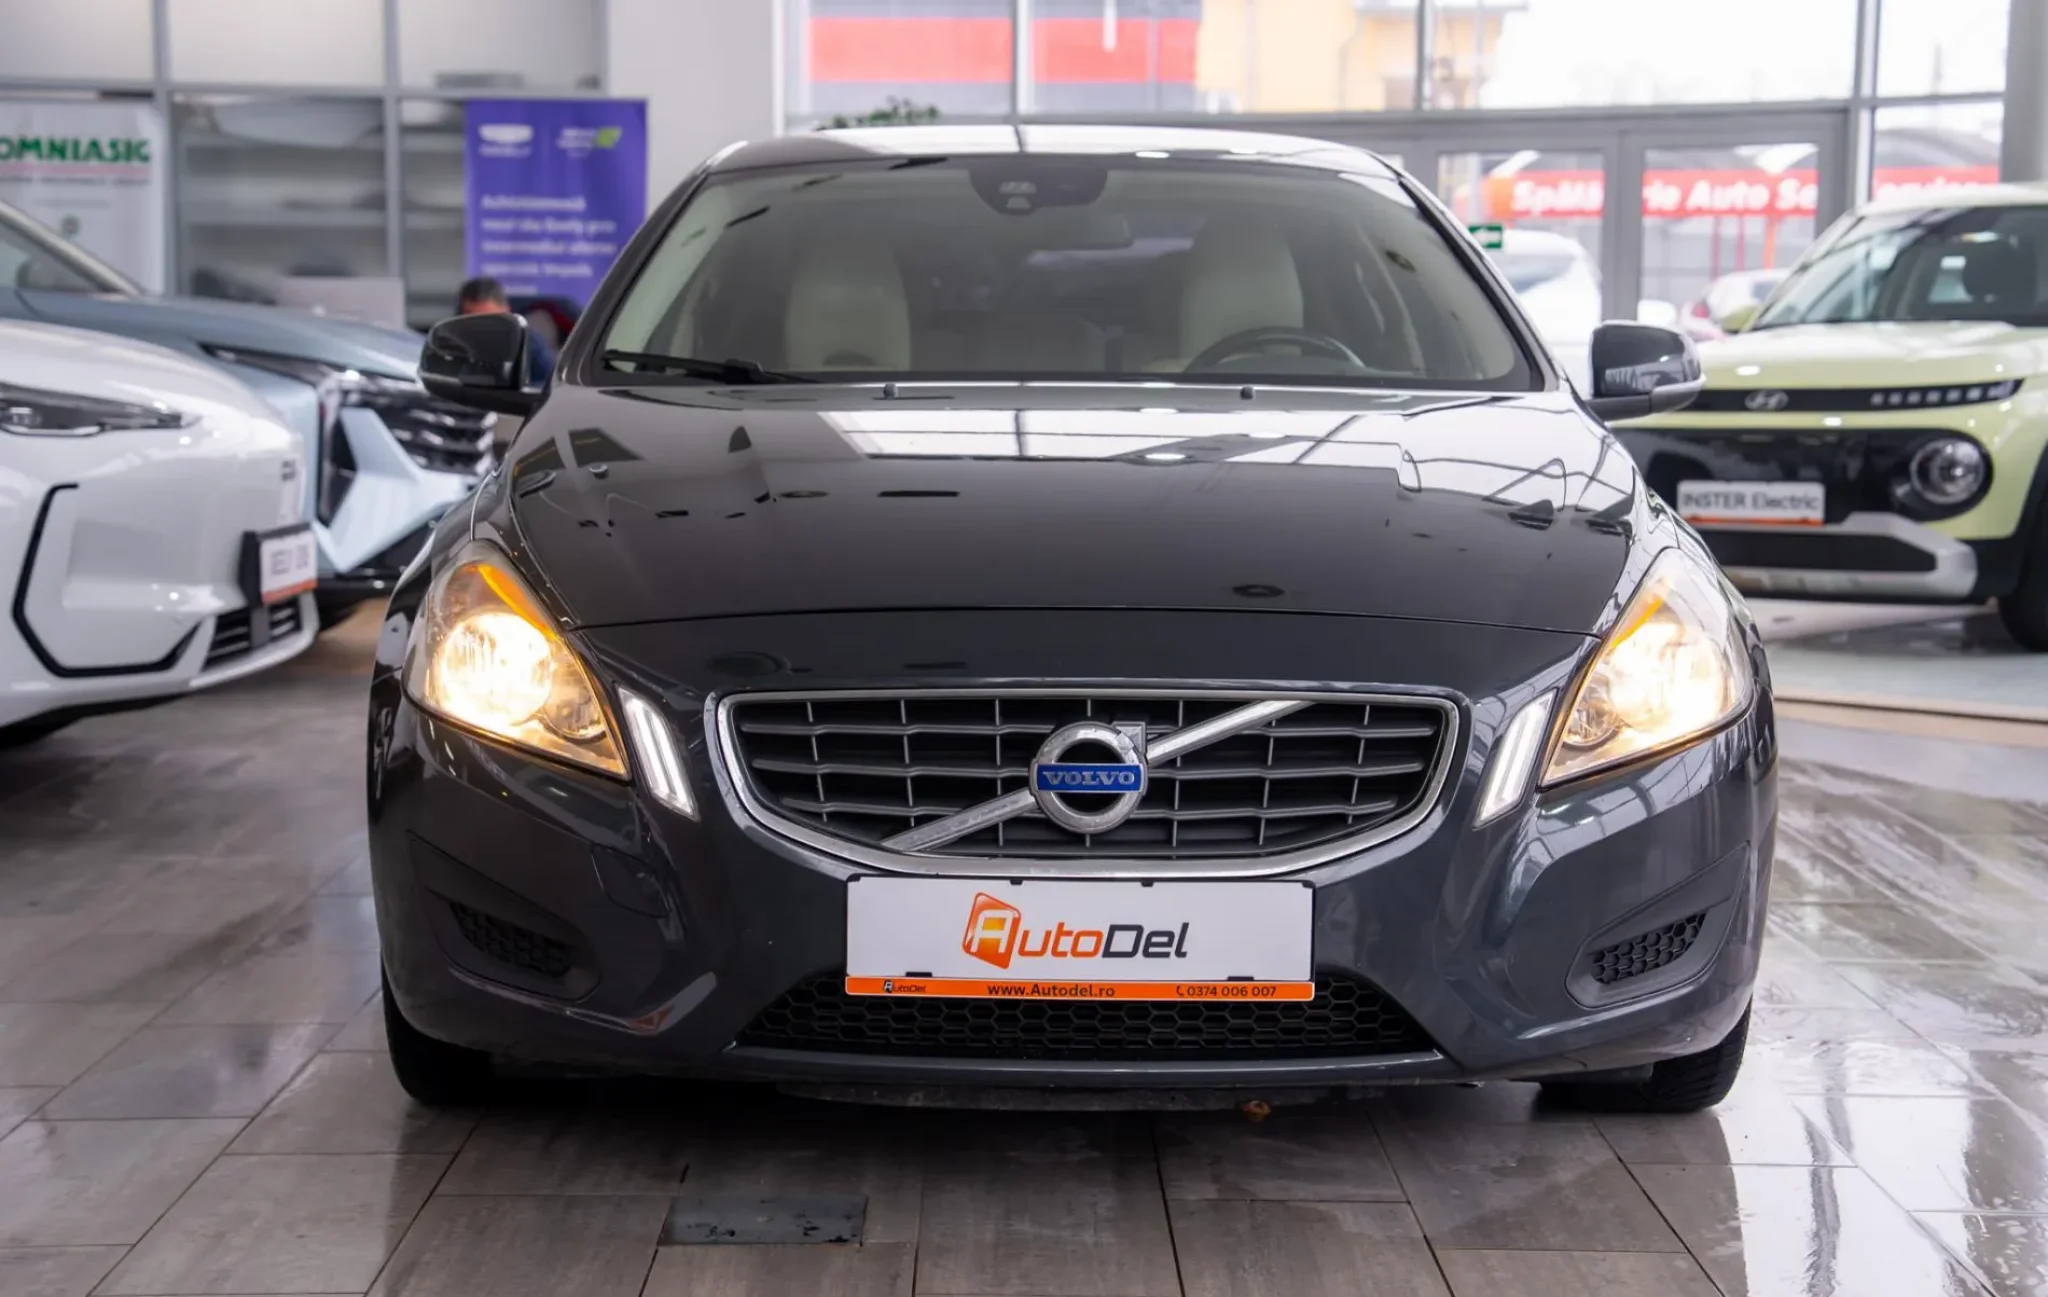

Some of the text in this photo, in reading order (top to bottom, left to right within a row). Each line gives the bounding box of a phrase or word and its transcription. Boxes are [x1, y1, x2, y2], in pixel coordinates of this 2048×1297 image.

[1686, 180, 1770, 210] Auto
[1683, 491, 1819, 510] INSTER Electric
[1042, 771, 1135, 786] VOLVO
[968, 908, 1190, 959] AutoDel
[988, 983, 1115, 998] www.Autodel.ro
[1187, 986, 1277, 996] 0374 006 007
